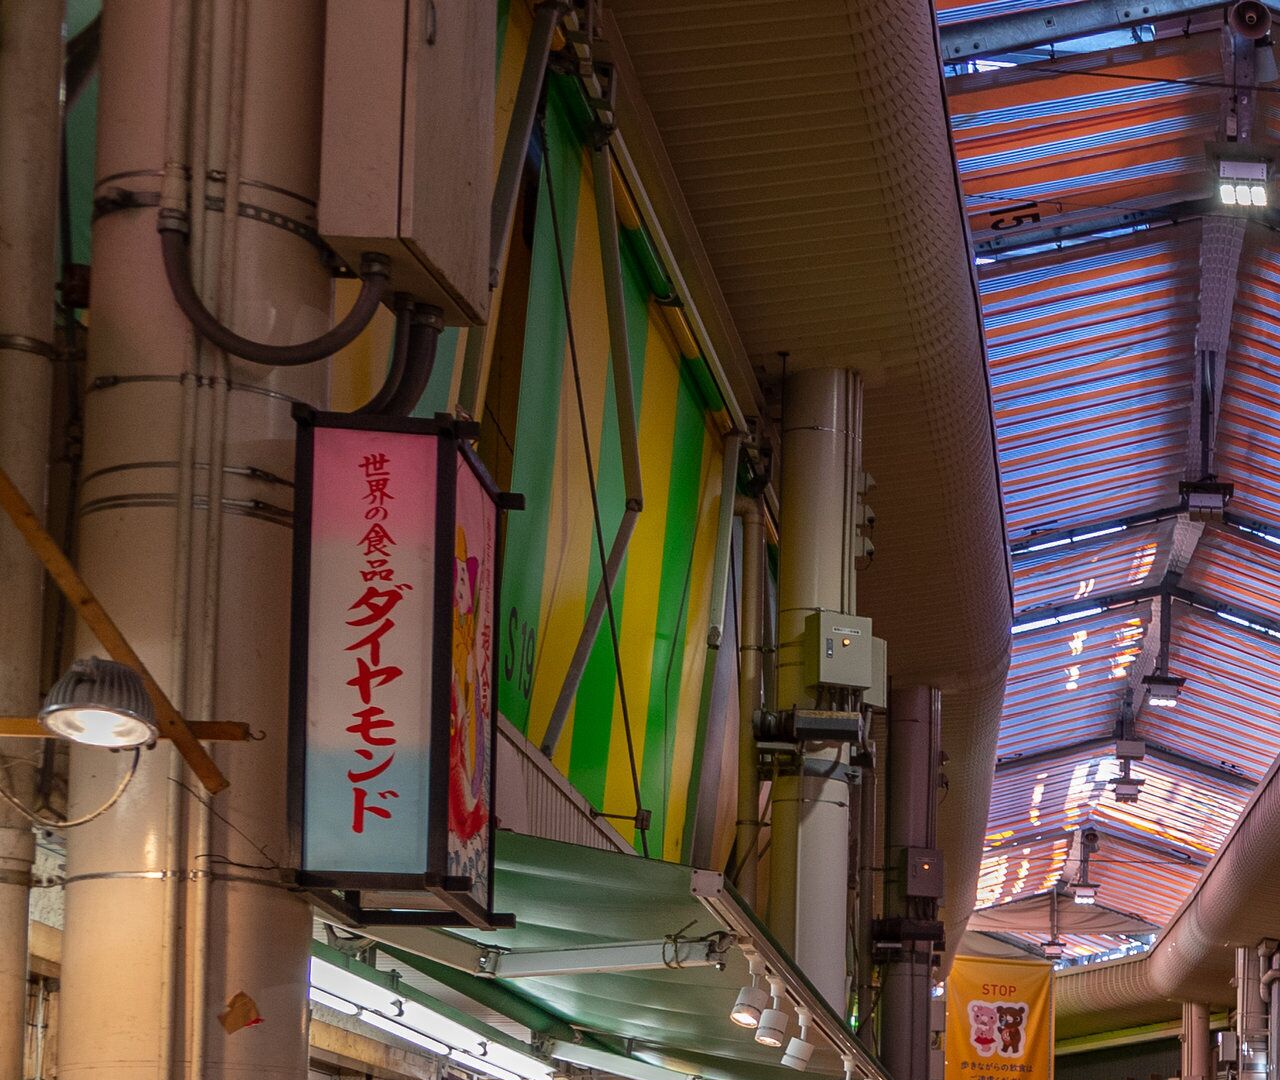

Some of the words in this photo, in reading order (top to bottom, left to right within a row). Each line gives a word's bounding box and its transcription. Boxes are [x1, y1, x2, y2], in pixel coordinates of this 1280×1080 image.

[357, 453, 397, 582] 世界の食品
[344, 584, 412, 834] ダイヤモンド
[982, 983, 1017, 997] STOP
[960, 1061, 1033, 1073] 歩きながらの飲食は
